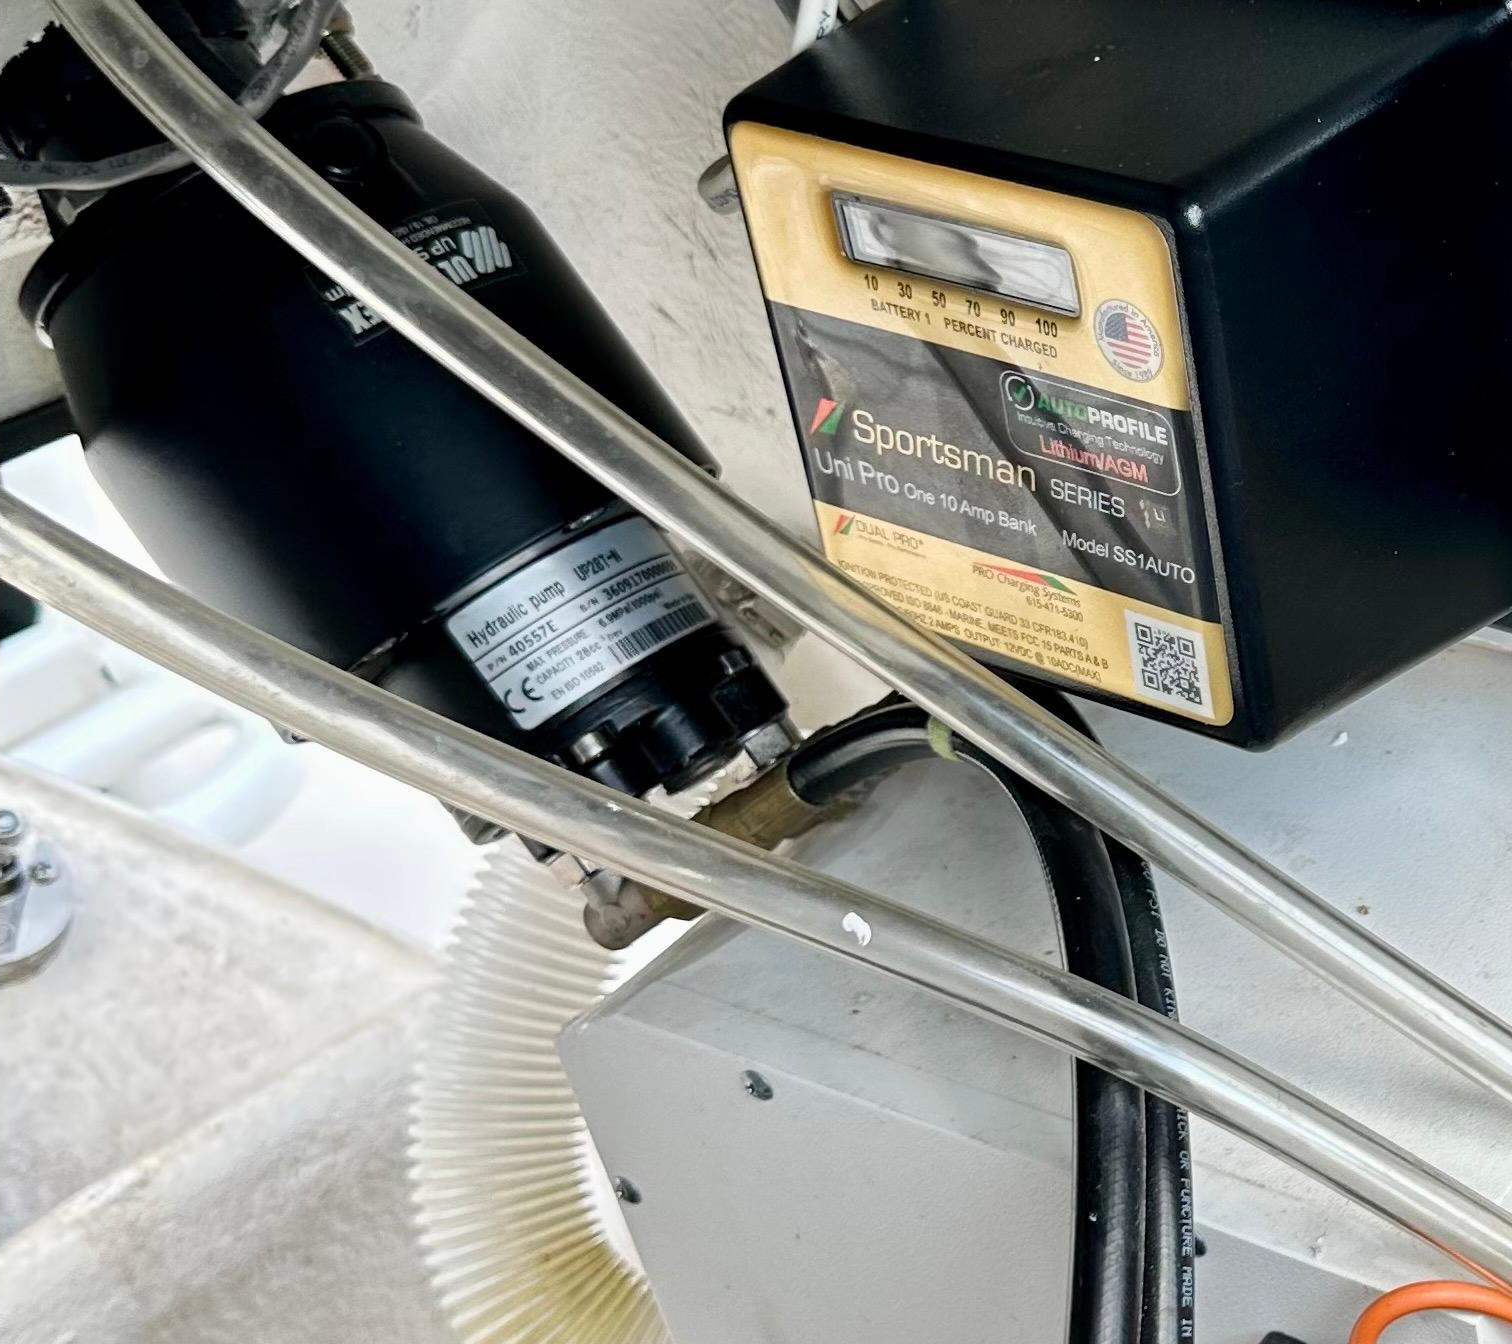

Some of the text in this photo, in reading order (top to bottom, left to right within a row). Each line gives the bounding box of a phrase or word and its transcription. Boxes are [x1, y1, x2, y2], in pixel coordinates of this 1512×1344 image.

[431, 235, 457, 257] UP
[863, 273, 1058, 338] 10 30 50 70 90 100
[870, 298, 1058, 359] BATTERY 1 PERCENT CHARGED
[1039, 394, 1168, 446] AUTOPROFILE
[852, 409, 1126, 519] Sportsman SERIES
[1039, 434, 1149, 484] Lithium/AGM
[1058, 422, 1105, 449] Charging
[1105, 435, 1165, 466] Technology
[814, 447, 1196, 585] Uni Pro One 10 Amp Bank Model SS1AUTO
[855, 519, 890, 541] DUAL
[878, 571, 933, 598] PROTECTED
[951, 595, 983, 613] COAST
[984, 604, 1018, 625] GUARD
[972, 565, 1081, 608] PRO Charging Systems
[467, 602, 528, 648] Hydraulic
[529, 581, 566, 612] pump
[935, 618, 962, 636] AMPS
[508, 620, 559, 657] 40557E
[526, 654, 546, 672] MAX
[546, 629, 589, 660] PRESSURE
[1021, 631, 1040, 647] FCC
[1041, 639, 1053, 652] 15
[1053, 642, 1085, 662] PARTS
[1101, 657, 1110, 671] B
[536, 655, 576, 685] CAPACITY
[1179, 1150, 1190, 1170] OR
[1180, 1177, 1193, 1257] PUNCTURE
[1182, 1266, 1194, 1307] MADE
[1181, 1318, 1193, 1338] IN
